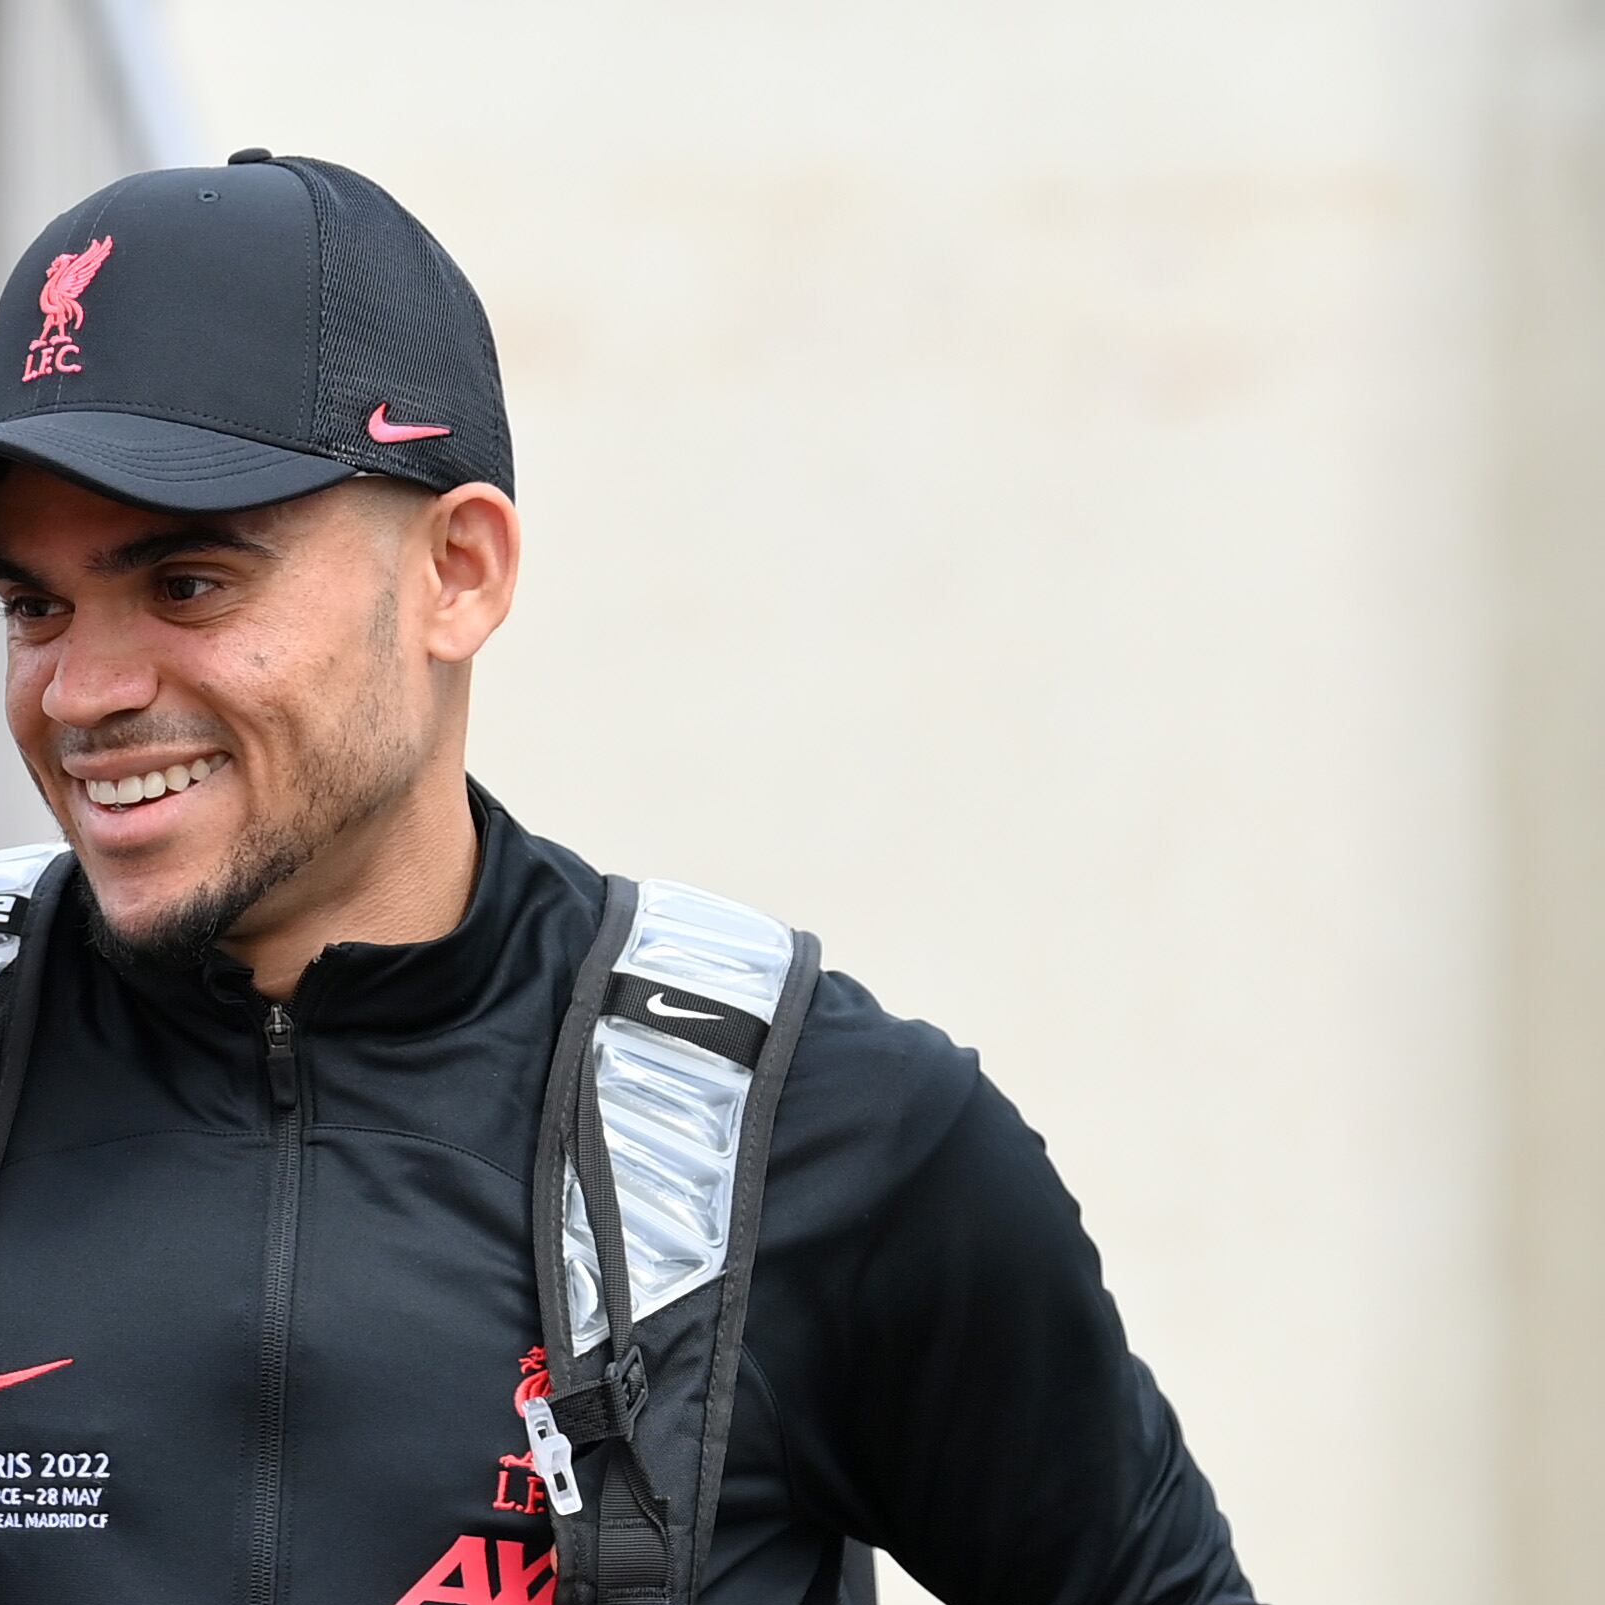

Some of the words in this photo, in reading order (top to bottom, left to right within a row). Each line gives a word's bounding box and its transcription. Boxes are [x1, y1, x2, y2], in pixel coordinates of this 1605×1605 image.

[40, 1453, 110, 1478] 2022
[36, 1488, 59, 1505] 28
[62, 1487, 102, 1506] MAY
[25, 1513, 87, 1528] MADRID
[88, 1513, 109, 1528] CF
